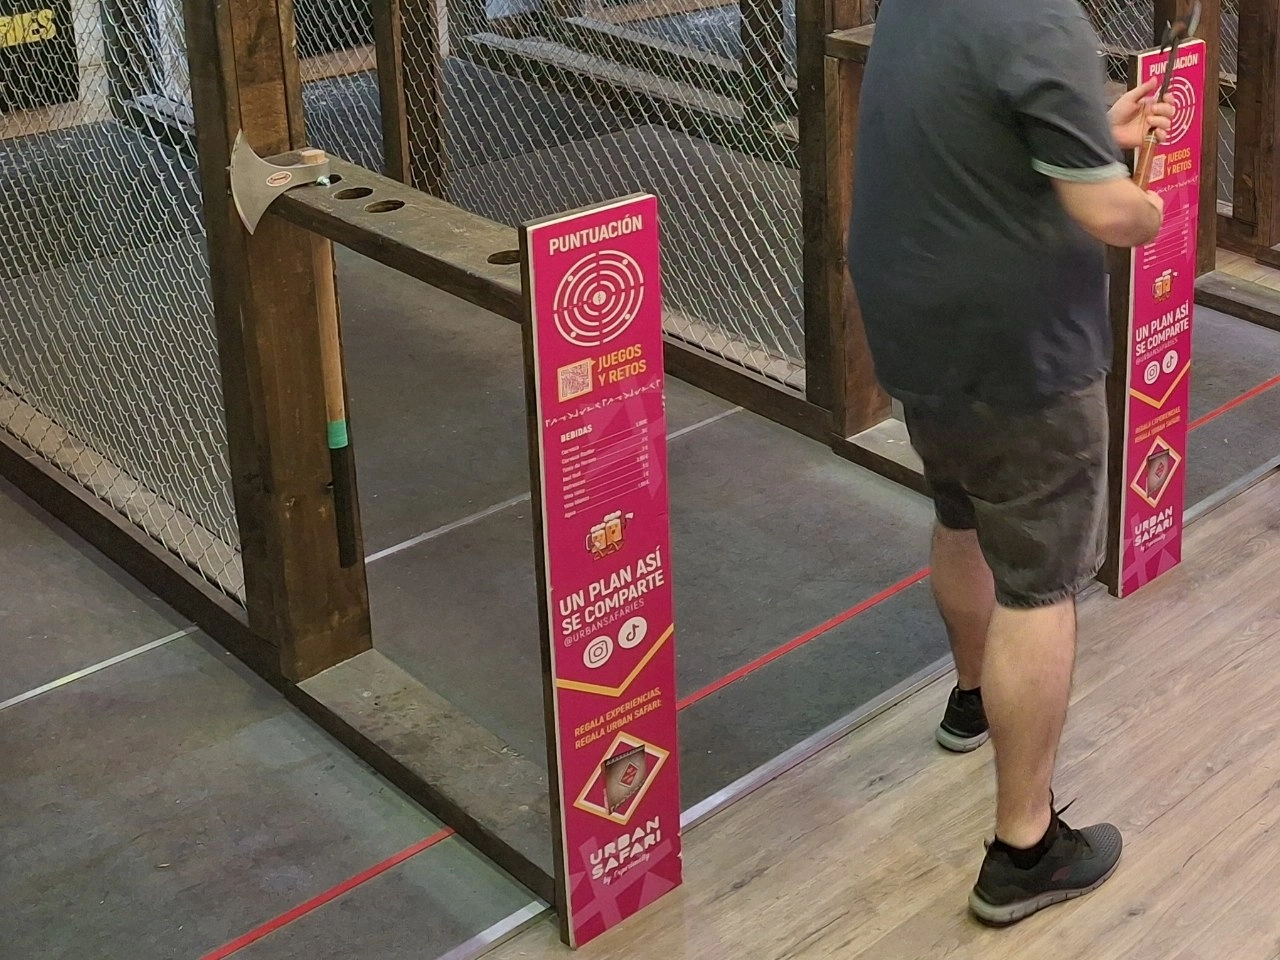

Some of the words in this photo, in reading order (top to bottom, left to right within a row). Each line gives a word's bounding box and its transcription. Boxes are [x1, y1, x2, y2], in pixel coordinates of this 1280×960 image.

[1150, 52, 1198, 76] PUNACIÓN
[1167, 147, 1191, 165] JUEGOS
[1172, 159, 1192, 174] RETOS
[549, 214, 643, 255] PUNTUACIÓN
[1136, 324, 1149, 342] UN
[1151, 310, 1173, 334] PLAN
[1175, 299, 1189, 321] ASÍ
[1136, 341, 1146, 356] SE
[1147, 317, 1189, 349] COMPARTE
[598, 343, 642, 372] JUEGOS
[598, 373, 606, 387] Y
[609, 359, 647, 384] RETOS
[561, 424, 592, 443] BEBIDAS
[1135, 505, 1172, 535] URBAN
[1135, 516, 1173, 546] SAFARI
[560, 590, 584, 616] UN
[589, 565, 632, 602] PLAN
[636, 545, 662, 578] ASÍ
[562, 613, 582, 635] SE
[584, 569, 665, 623] COMPARTE
[564, 598, 645, 647] @URBANSAFARIES
[574, 715, 605, 737] REGALA
[575, 729, 606, 749] REGALA
[606, 713, 633, 733] URBAN
[590, 815, 660, 865] URBAN
[591, 829, 661, 880] SAFARI
